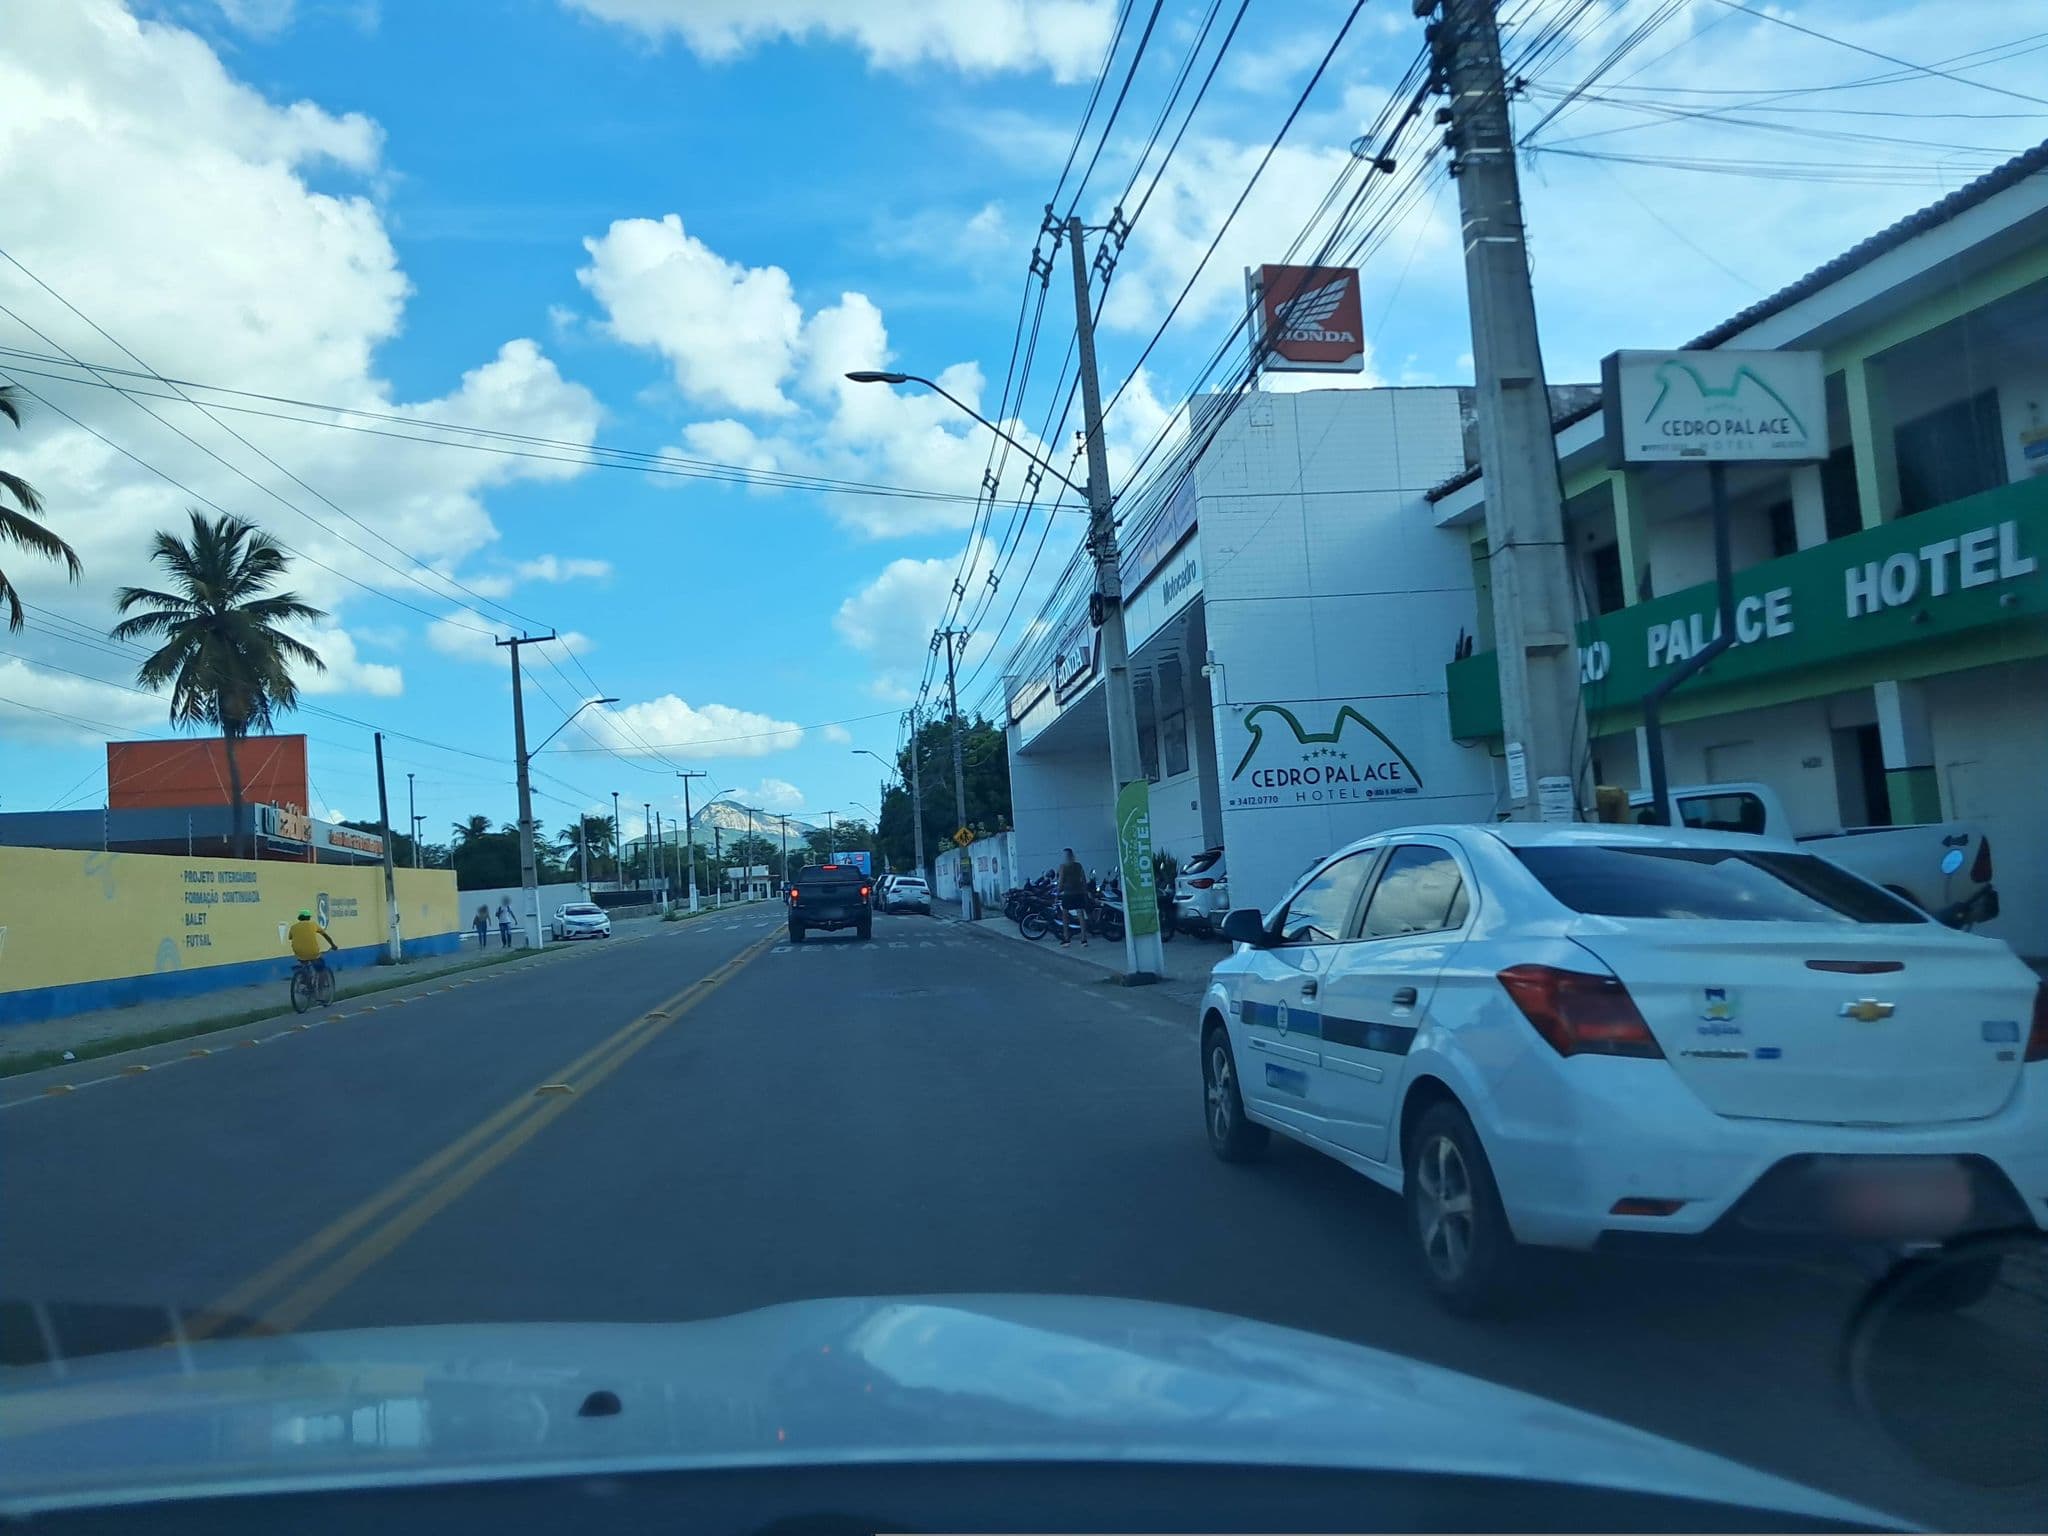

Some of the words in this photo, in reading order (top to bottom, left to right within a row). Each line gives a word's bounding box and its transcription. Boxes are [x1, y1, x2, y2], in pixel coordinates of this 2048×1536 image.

[1276, 330, 1356, 343] HONDA
[1661, 419, 1721, 437] CEDRO
[1725, 417, 1791, 435] PALACE
[1845, 521, 2038, 619] HOTEL
[1162, 558, 1197, 607] Motocedro
[1251, 767, 1321, 788] CEDRO
[1326, 762, 1402, 784] PALACE
[1296, 788, 1360, 802] HOTEL
[1136, 812, 1153, 888] HOTEL
[184, 870, 215, 883] PROJETO
[186, 934, 212, 948] FUTSAL
